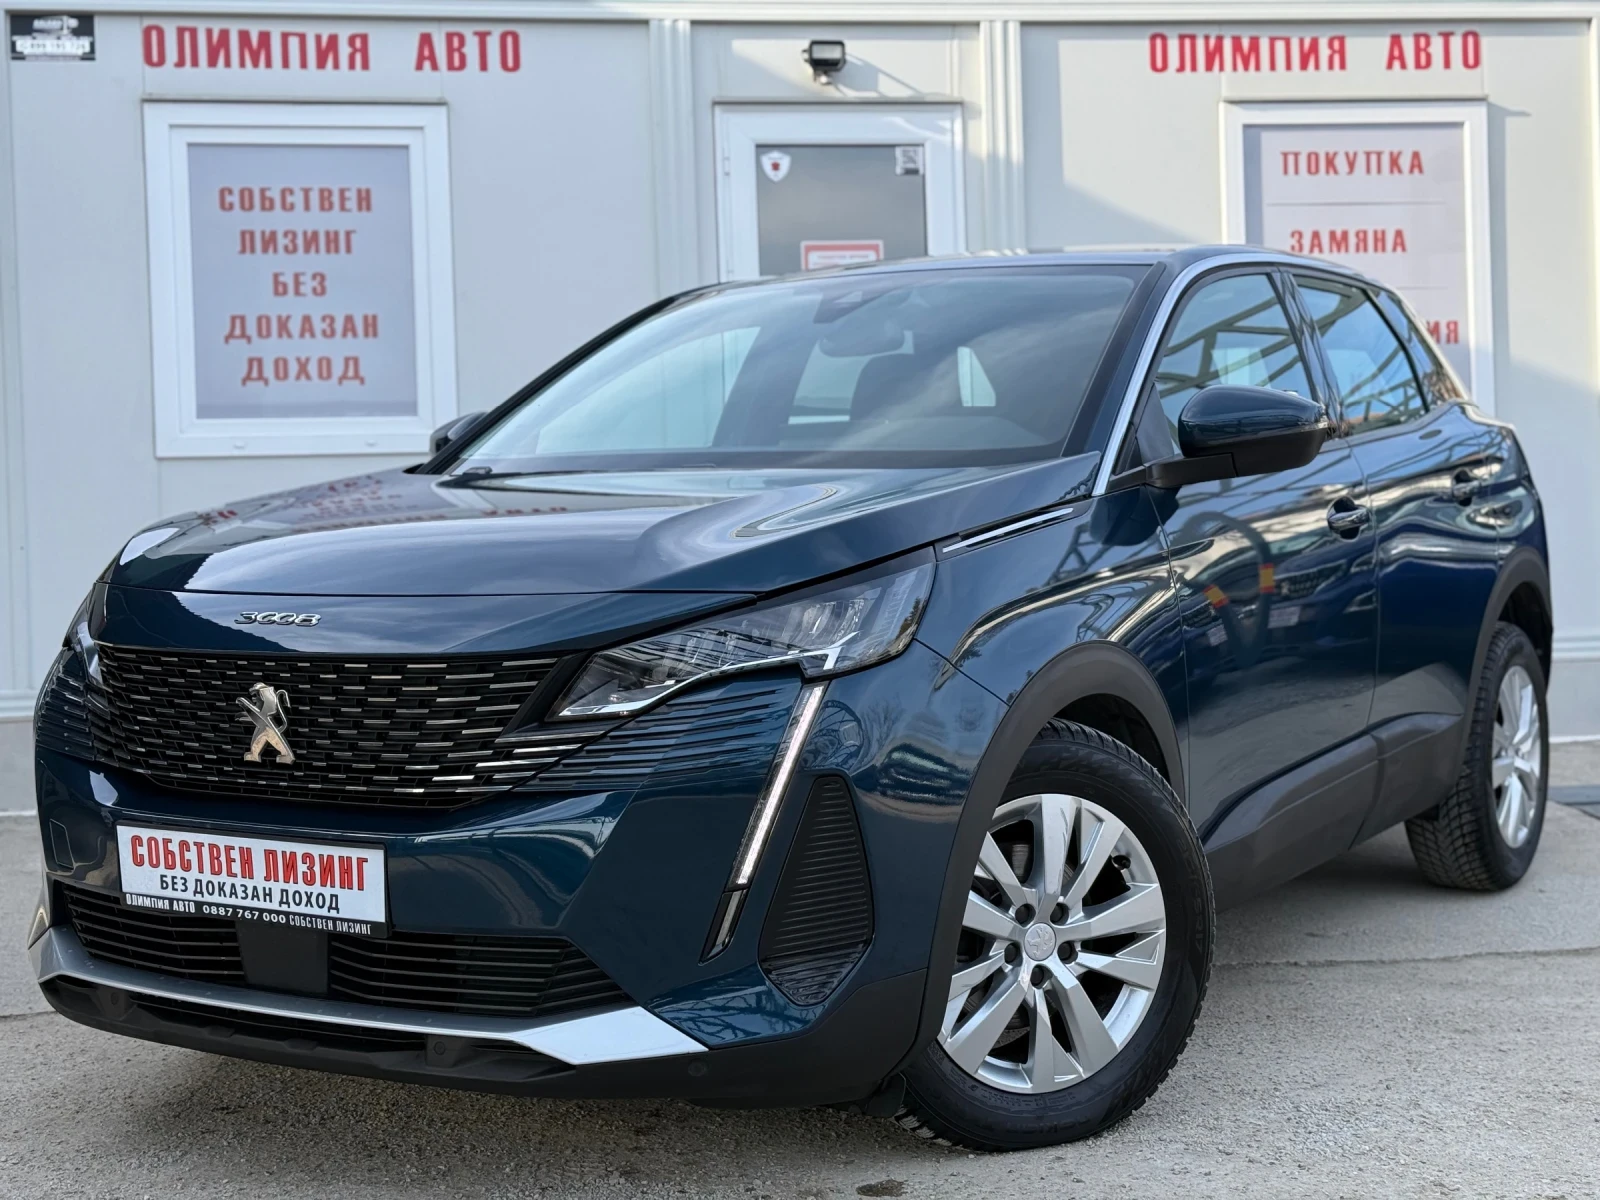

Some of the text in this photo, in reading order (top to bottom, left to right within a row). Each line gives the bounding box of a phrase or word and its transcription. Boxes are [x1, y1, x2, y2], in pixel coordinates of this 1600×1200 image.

[142, 24, 521, 73] ОЛИМПИЯ АВТО
[1148, 30, 1482, 74] ОЛИМПИЯ АВТО
[1281, 150, 1424, 175] ПОКУПКА
[219, 187, 372, 212] СОБСТВЕН
[239, 230, 356, 253] ЛИЗИНГ
[1290, 228, 1407, 254] ЗАМЯНА
[274, 273, 325, 296] БЕЗ
[225, 315, 378, 343] ДОКАЗАН
[242, 358, 365, 385] ДОХОД
[234, 611, 321, 627] 3008
[130, 834, 369, 891] СОБСТВЕН ЛИЗИНГ
[160, 874, 340, 914] БЕЗ ДОКАЗАН ДОХОД
[125, 893, 371, 935] ОЛИМПИЯ АВТО 0887 767 000 СОБСТВЕН ЛИЗИНГ
